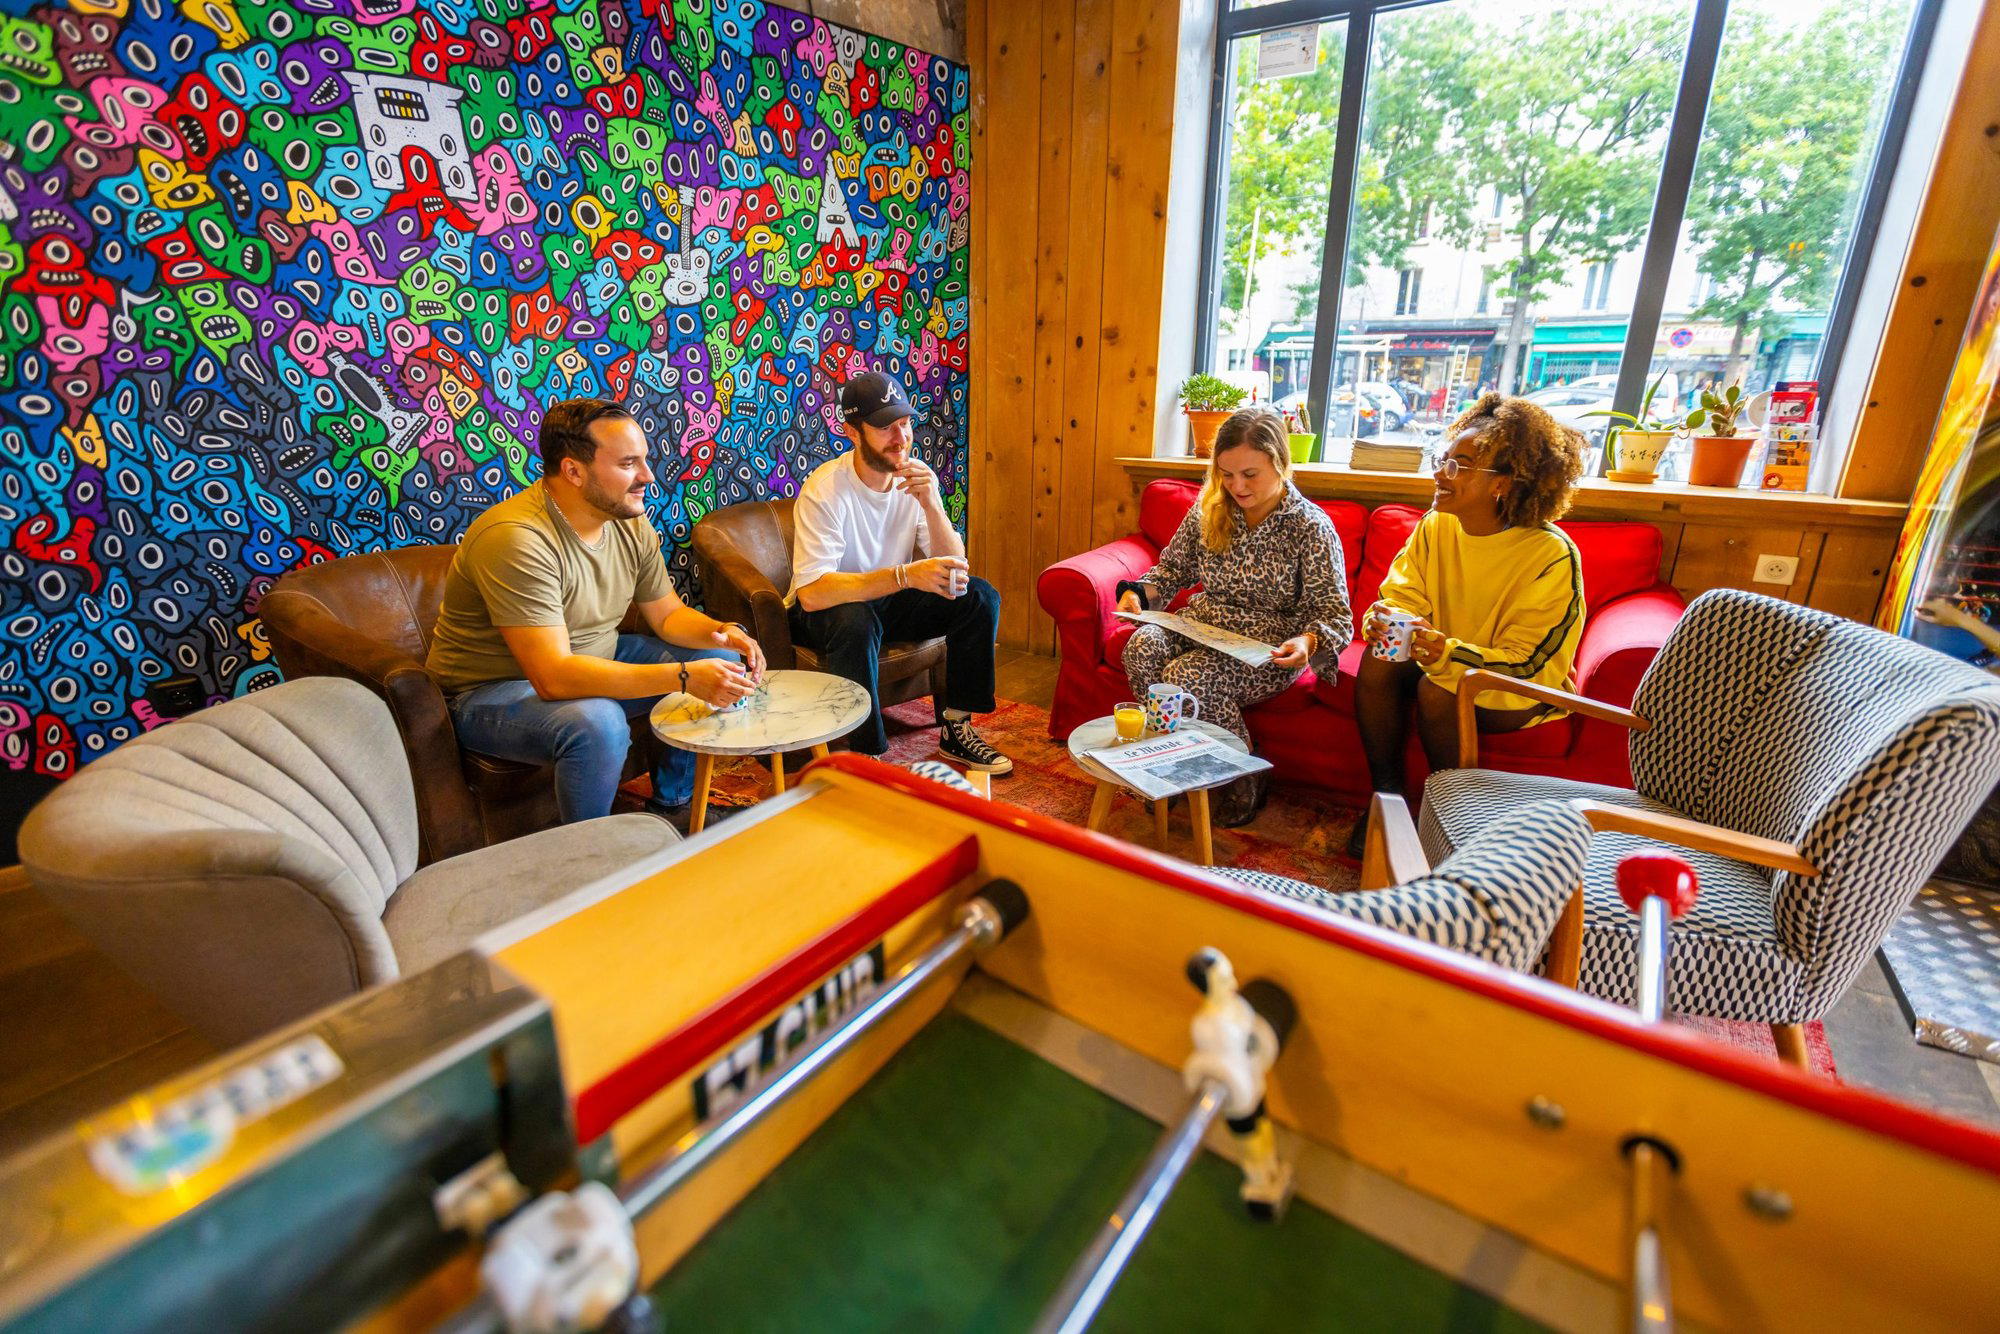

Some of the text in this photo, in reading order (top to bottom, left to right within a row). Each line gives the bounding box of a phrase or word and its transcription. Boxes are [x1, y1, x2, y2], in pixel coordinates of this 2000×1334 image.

[880, 381, 902, 404] A
[1123, 750, 1138, 758] Le
[1138, 740, 1184, 756] Monde
